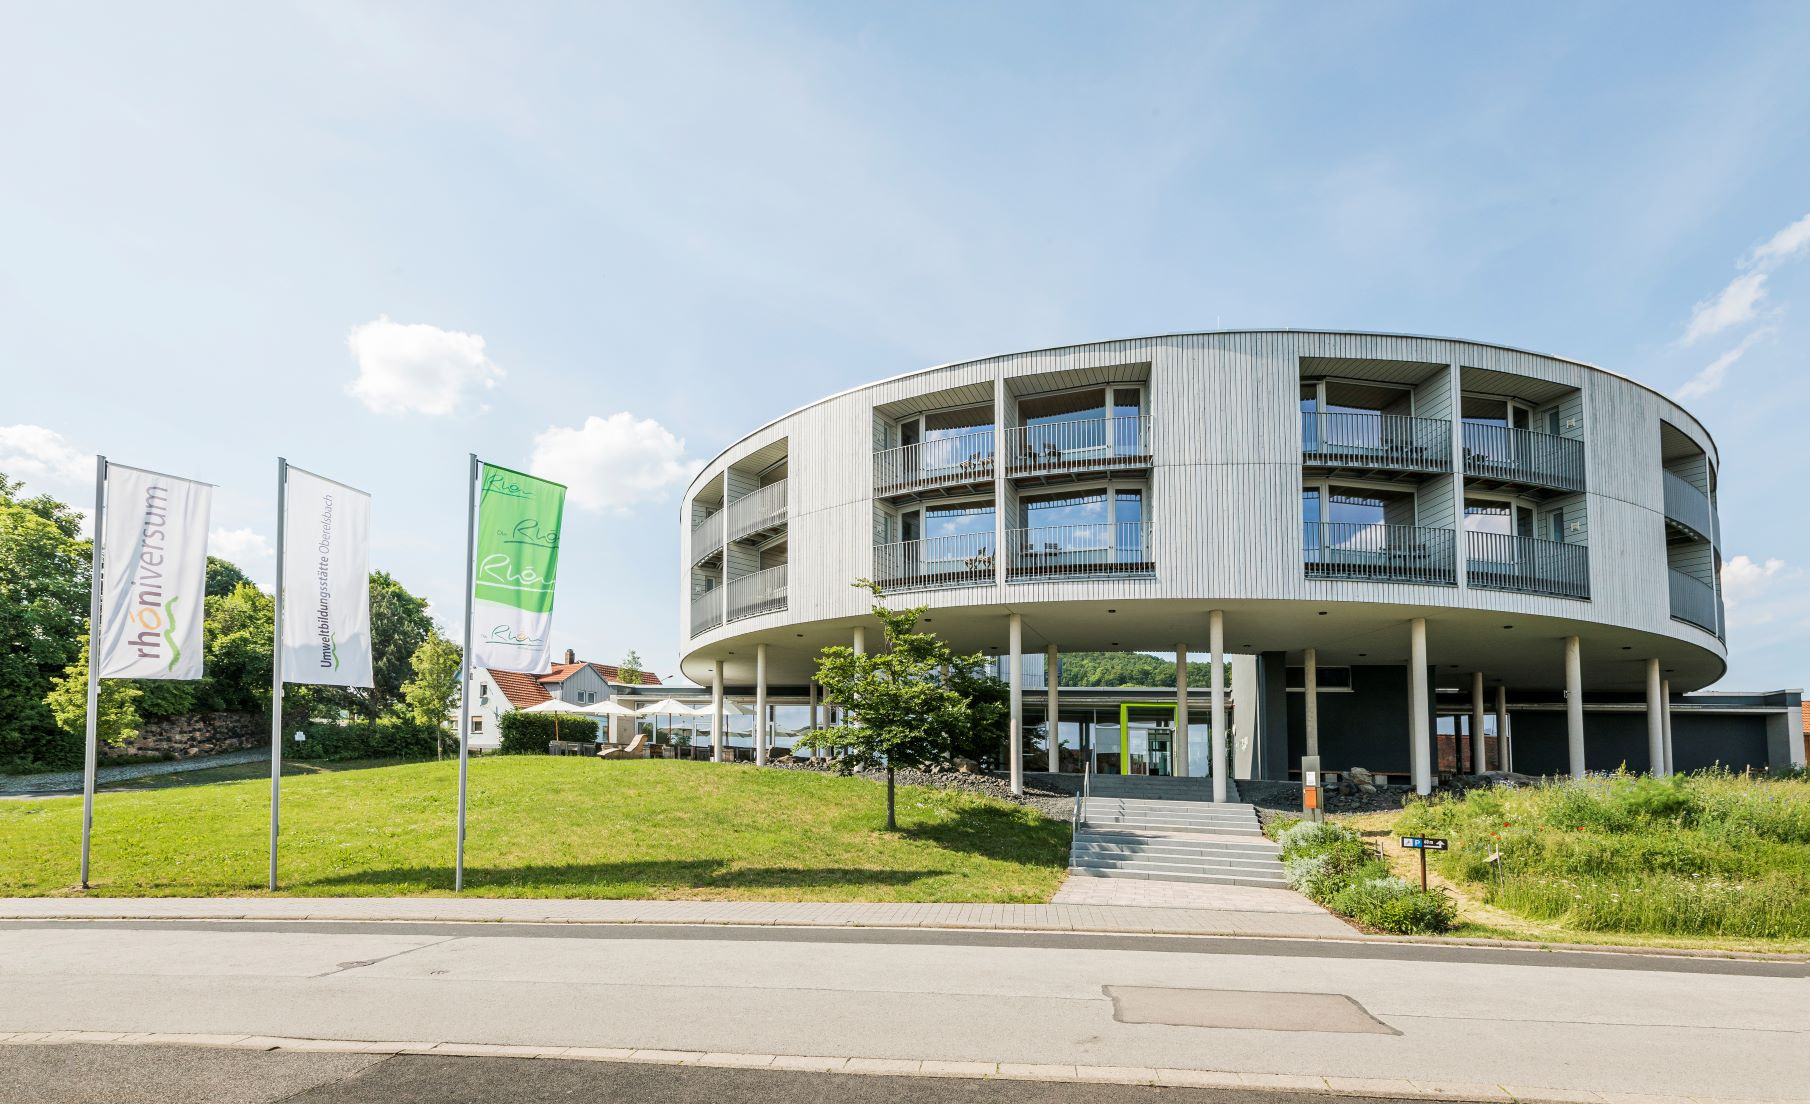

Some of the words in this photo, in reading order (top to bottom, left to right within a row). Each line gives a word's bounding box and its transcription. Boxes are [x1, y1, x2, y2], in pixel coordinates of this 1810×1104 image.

[128, 485, 168, 659] rhöniversum
[318, 494, 333, 554] Oberelsbach
[317, 556, 333, 668] Umweltbildungsstätte
